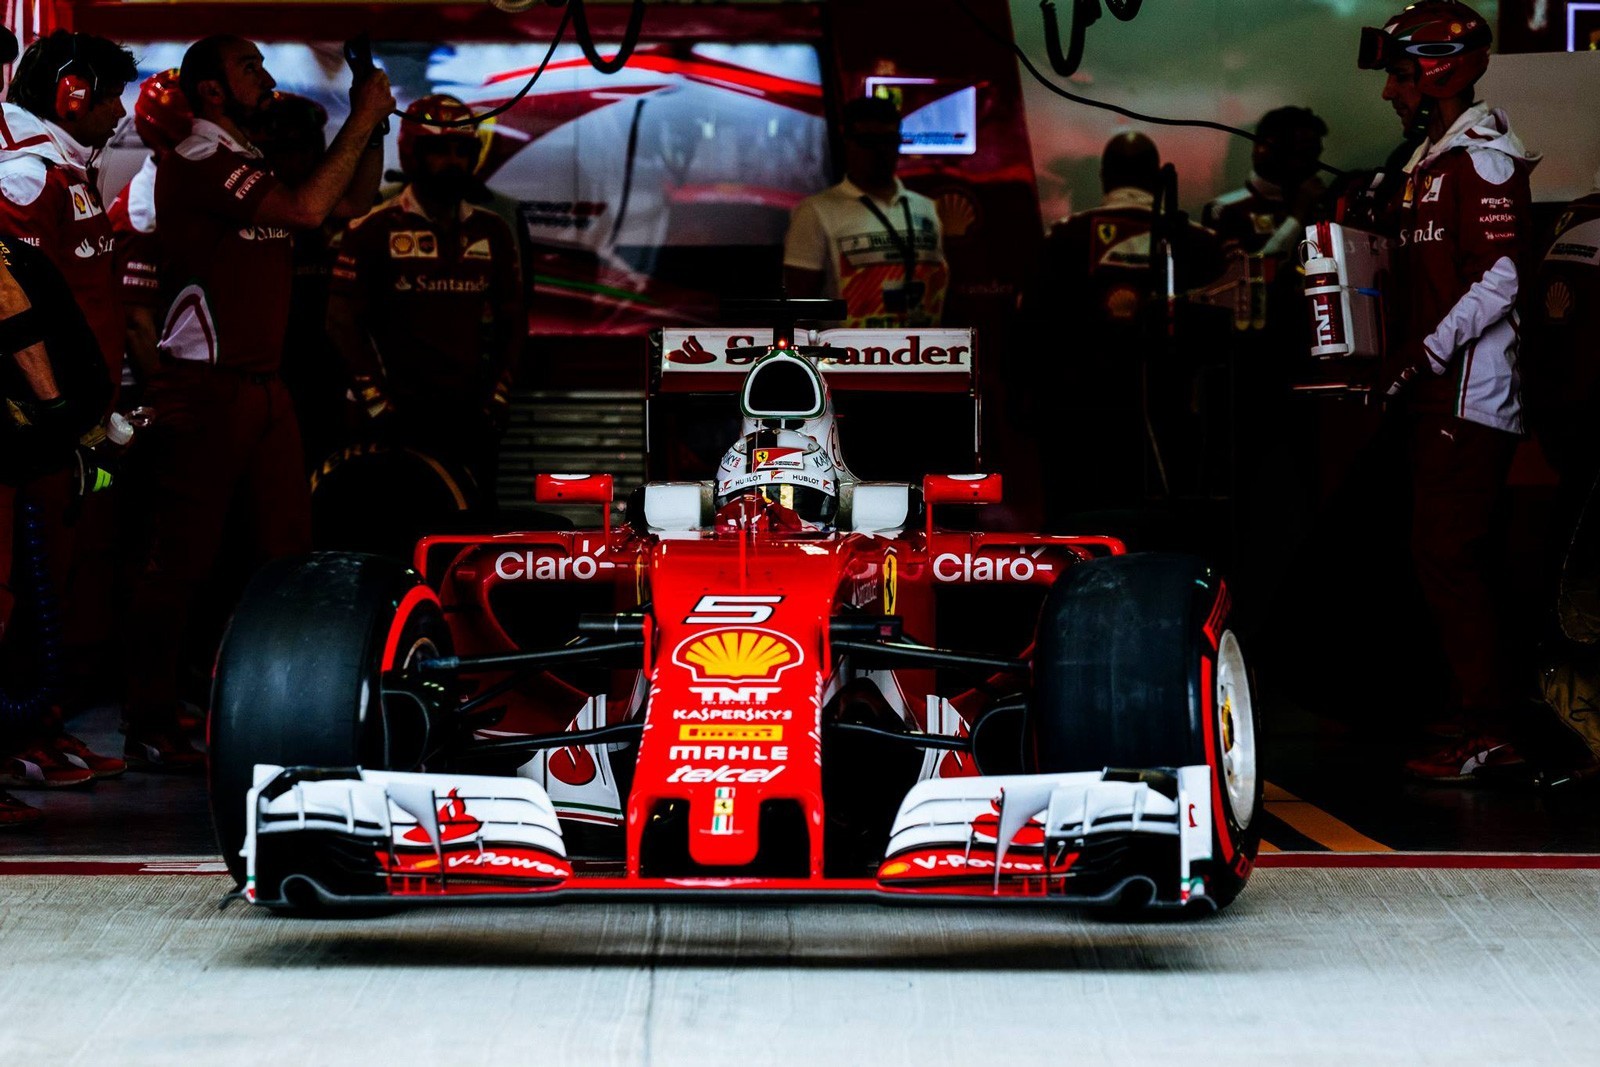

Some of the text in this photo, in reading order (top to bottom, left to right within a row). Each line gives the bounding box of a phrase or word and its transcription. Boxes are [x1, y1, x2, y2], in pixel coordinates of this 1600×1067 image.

[1313, 298, 1333, 346] TNT
[793, 474, 819, 486] HUBLOT
[684, 595, 783, 624] 5
[688, 686, 783, 702] TNT
[673, 707, 783, 722] KASPERSKY
[669, 745, 789, 761] MAHLE
[666, 764, 787, 783] telcel
